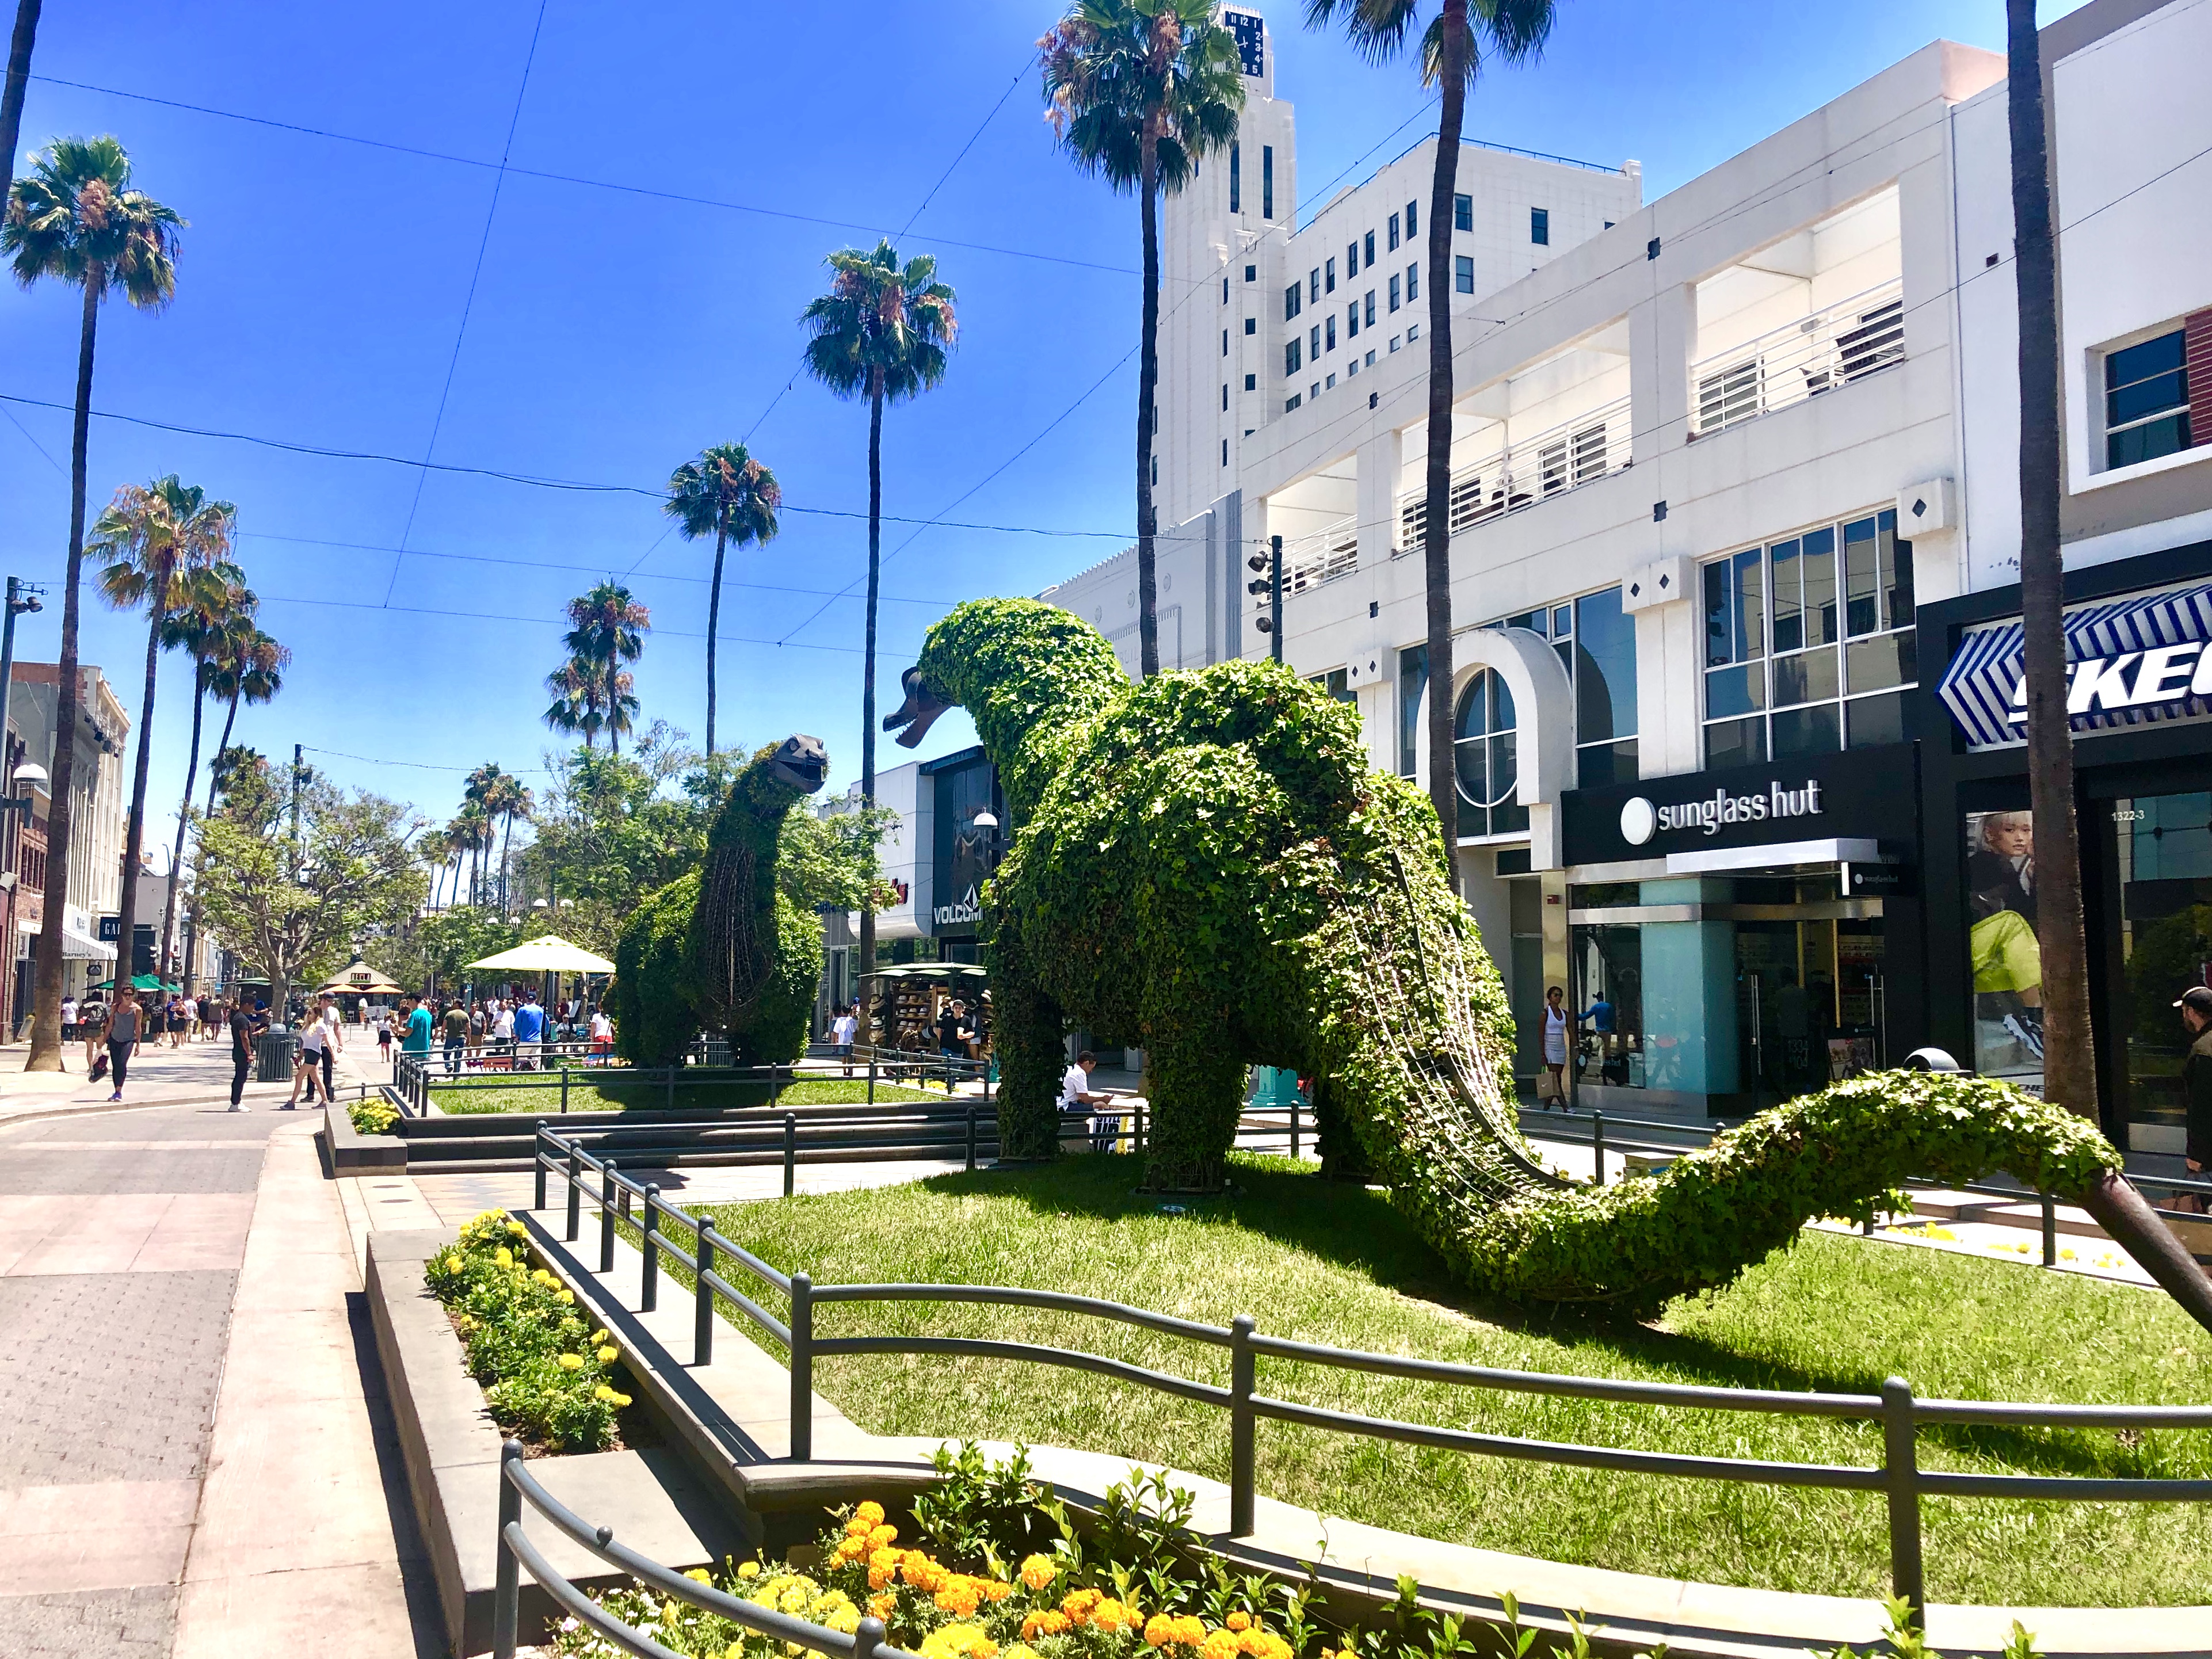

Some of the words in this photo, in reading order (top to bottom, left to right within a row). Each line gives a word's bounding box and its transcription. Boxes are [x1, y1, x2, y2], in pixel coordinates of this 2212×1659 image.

[1231, 14, 1237, 24] 11
[1240, 16, 1249, 26] 12
[1254, 19, 1257, 28] 1
[1255, 31, 1261, 41] 2
[1255, 42, 1261, 52] 3
[1254, 54, 1261, 63] 4
[1242, 62, 1248, 71] 6
[1252, 64, 1258, 74] 5
[1658, 788, 1769, 836] sunglass
[1771, 779, 1823, 818] hut
[2111, 810, 2145, 821] 1322-3
[933, 904, 982, 925] VOLCOM
